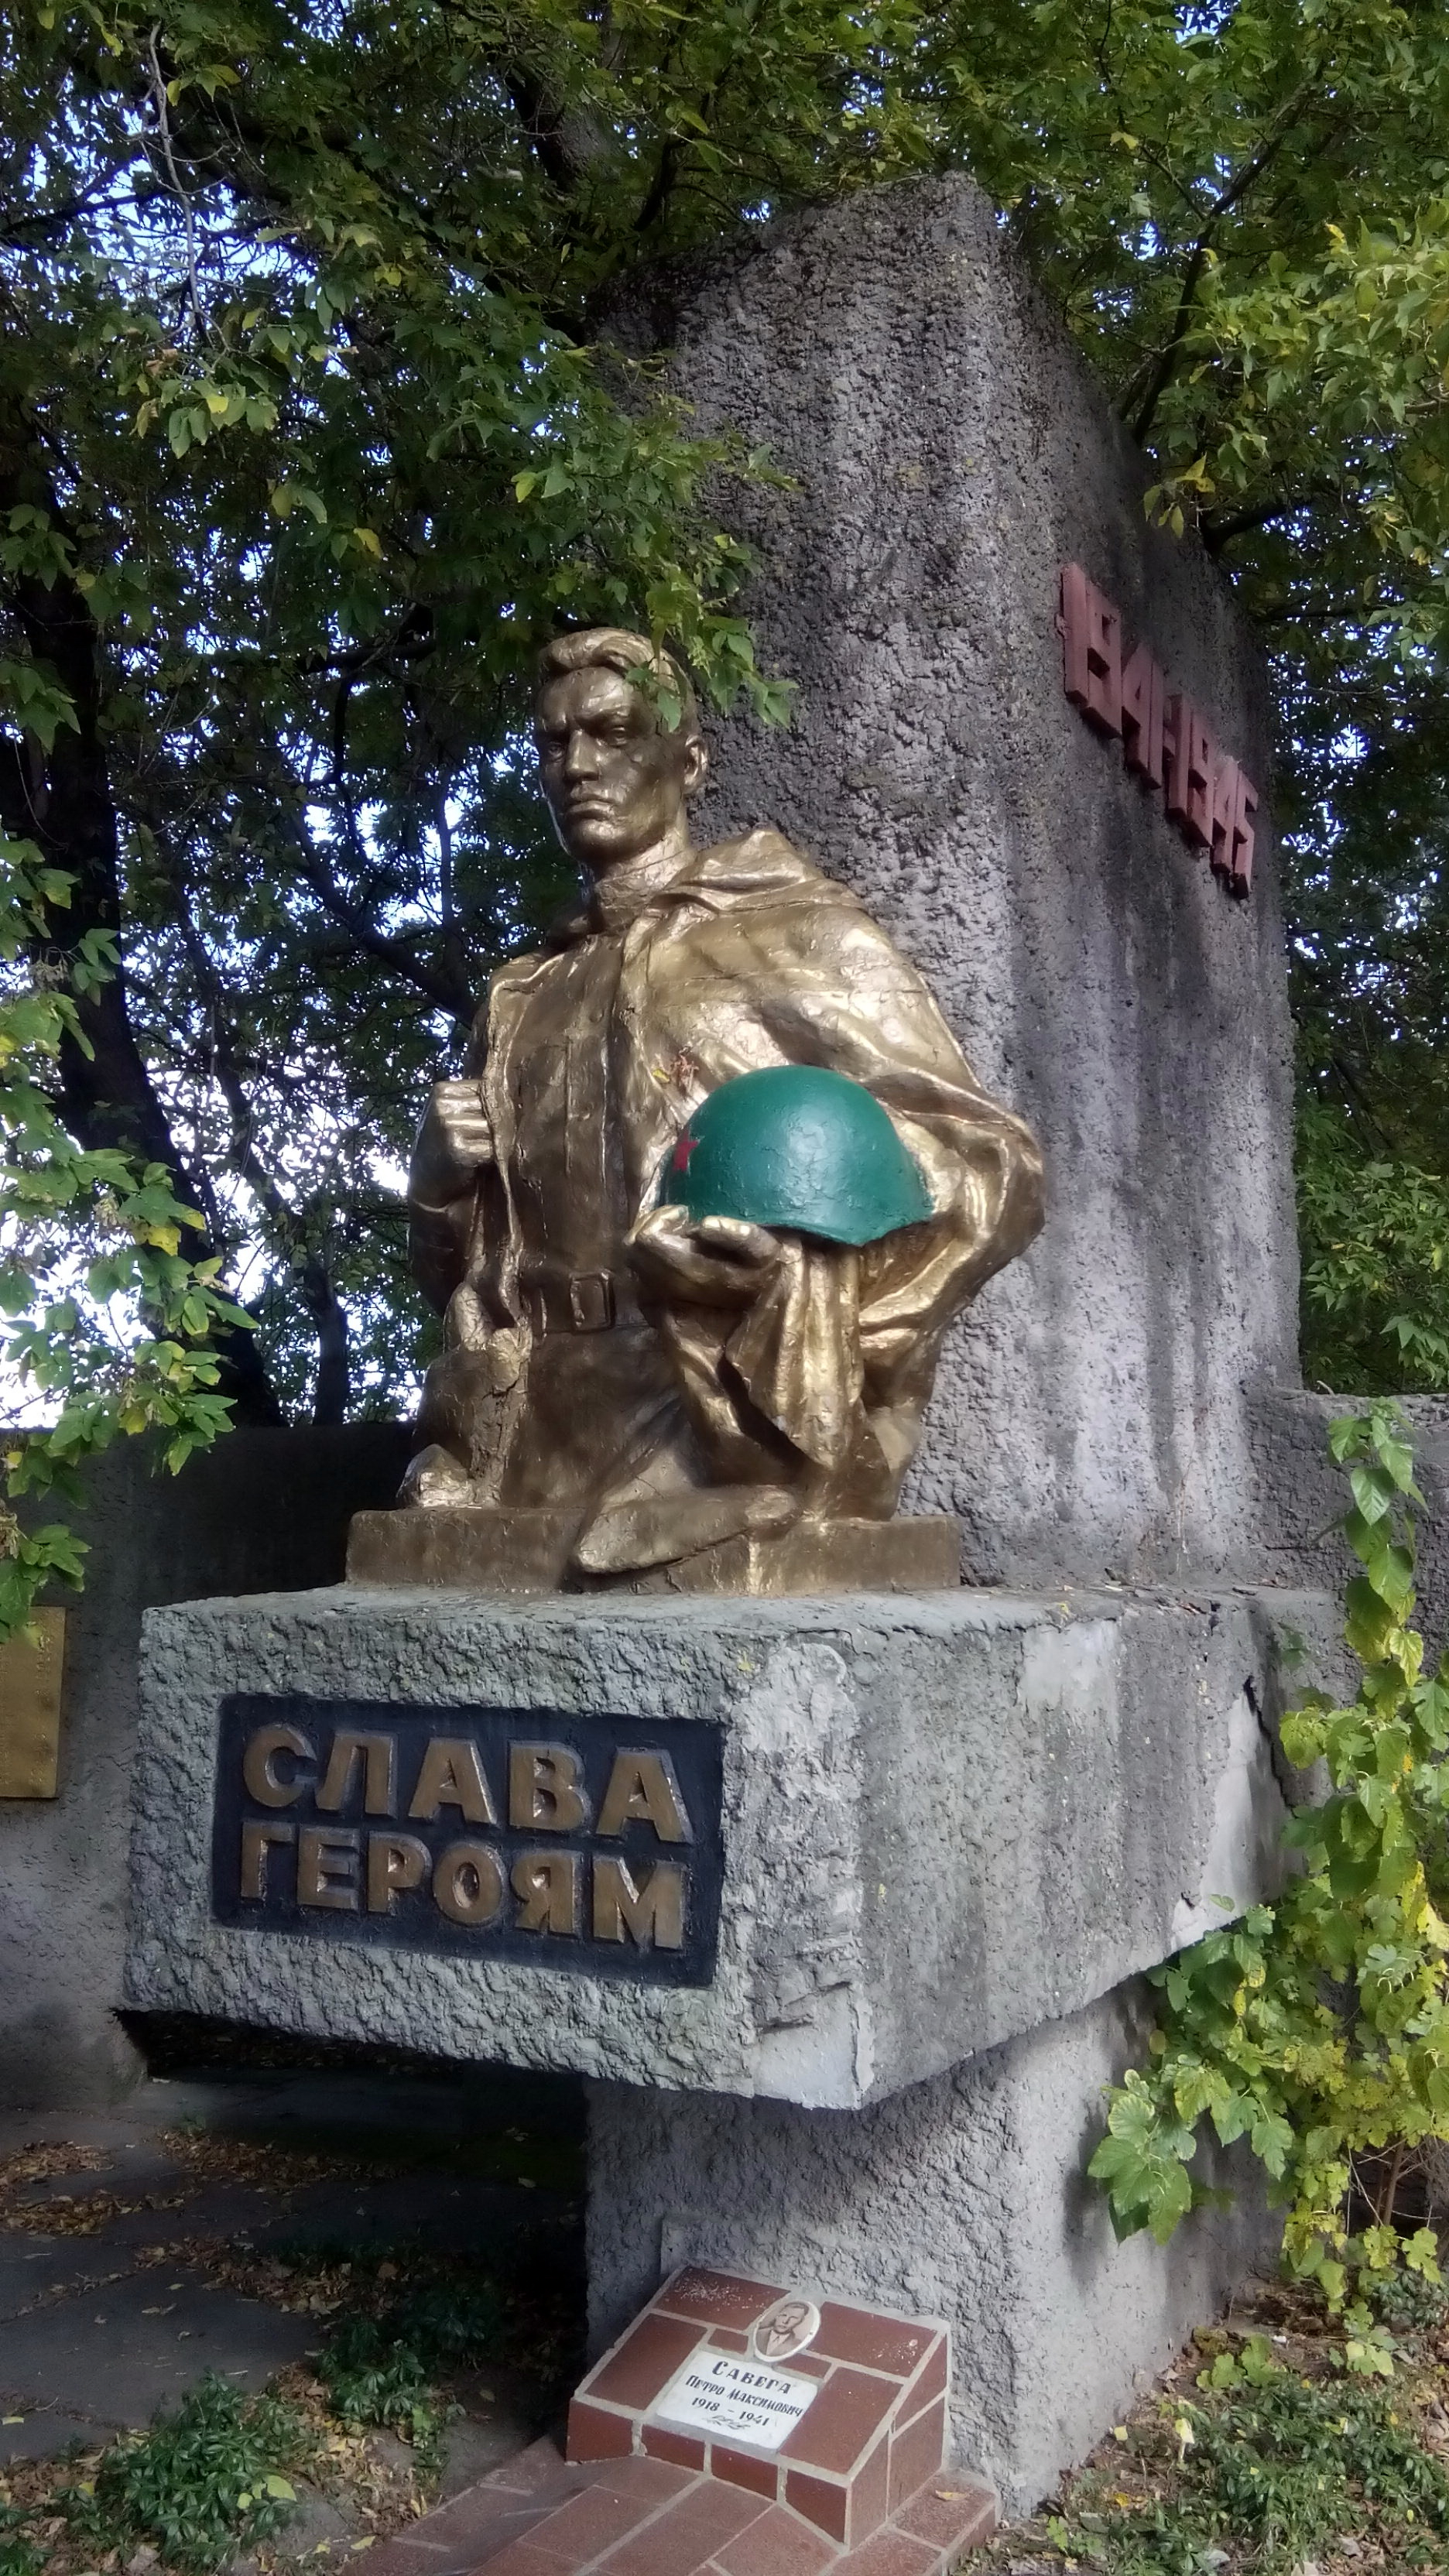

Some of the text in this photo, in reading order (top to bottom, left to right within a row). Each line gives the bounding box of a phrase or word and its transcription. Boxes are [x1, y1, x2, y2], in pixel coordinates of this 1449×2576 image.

[243, 1722, 693, 1844] СЛАВА
[240, 1819, 687, 1950] ГЕРОЯМ
[691, 2397, 721, 2412] 1918
[739, 2410, 770, 2427] 1941
